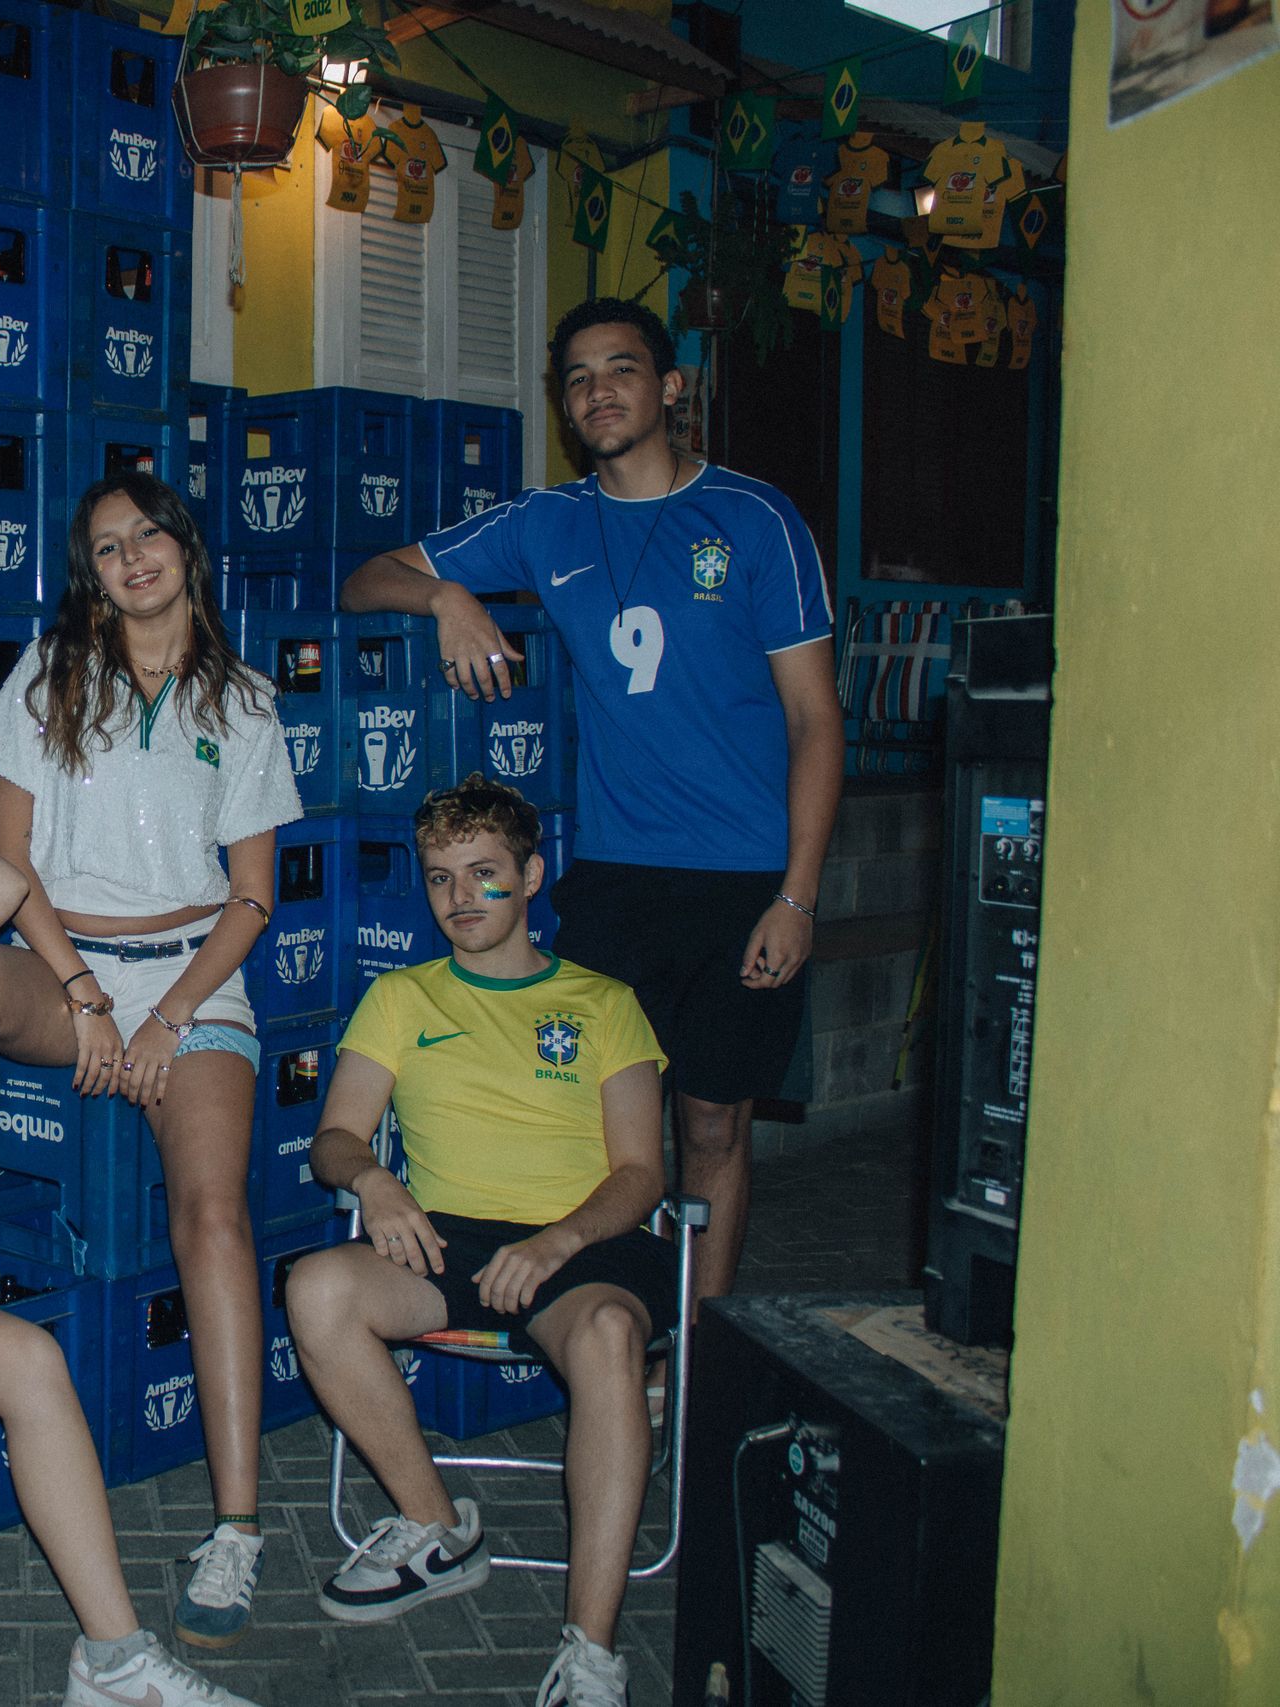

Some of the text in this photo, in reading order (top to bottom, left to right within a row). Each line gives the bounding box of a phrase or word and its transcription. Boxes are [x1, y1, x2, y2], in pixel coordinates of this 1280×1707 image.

[109, 127, 158, 151] AmBev
[105, 325, 154, 347] AmBev
[240, 465, 307, 488] AmBev
[360, 472, 400, 488] AmBev
[462, 486, 497, 501] AmBev
[693, 592, 724, 603] BRASIL
[298, 648, 321, 661] AHMA
[609, 605, 665, 695] 9
[489, 720, 544, 738] AmBev
[276, 927, 326, 946] AmBev
[357, 922, 413, 952] mbev
[549, 1037, 567, 1046] CBF
[299, 1050, 319, 1065] BRAH
[535, 1068, 580, 1084] BRASIL
[145, 1373, 195, 1400] AmBev
